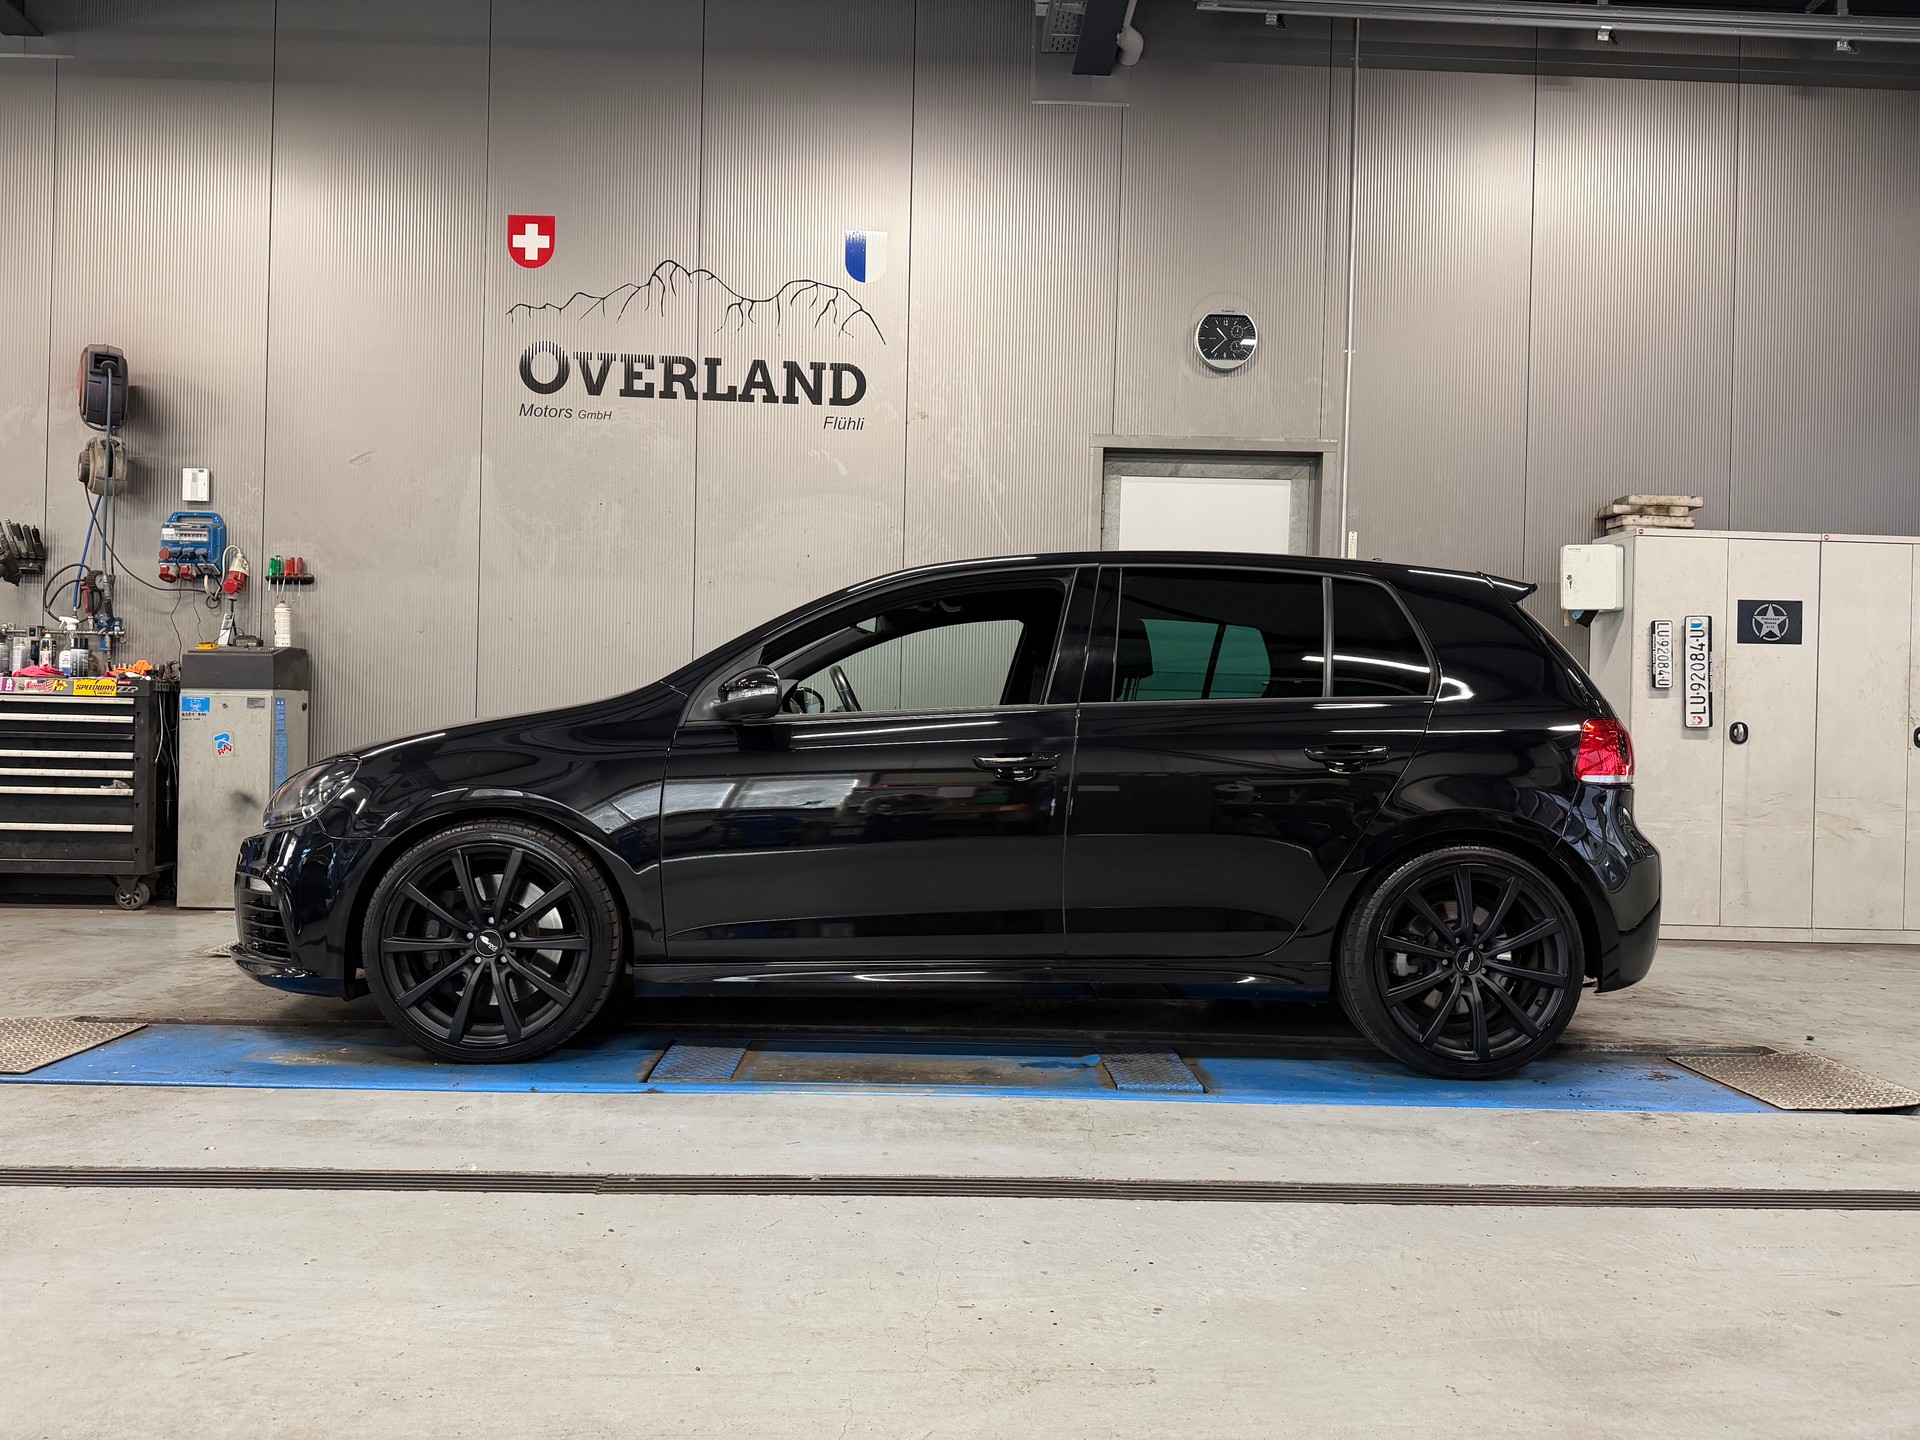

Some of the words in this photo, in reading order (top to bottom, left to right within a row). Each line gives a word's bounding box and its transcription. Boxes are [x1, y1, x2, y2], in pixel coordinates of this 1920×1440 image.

[519, 340, 867, 407] OVERLAND
[519, 404, 573, 420] Motors
[578, 410, 612, 421] GmbH
[823, 416, 865, 431] Flühli
[76, 684, 116, 692] SPEEDWAY
[217, 744, 232, 756] RAV
